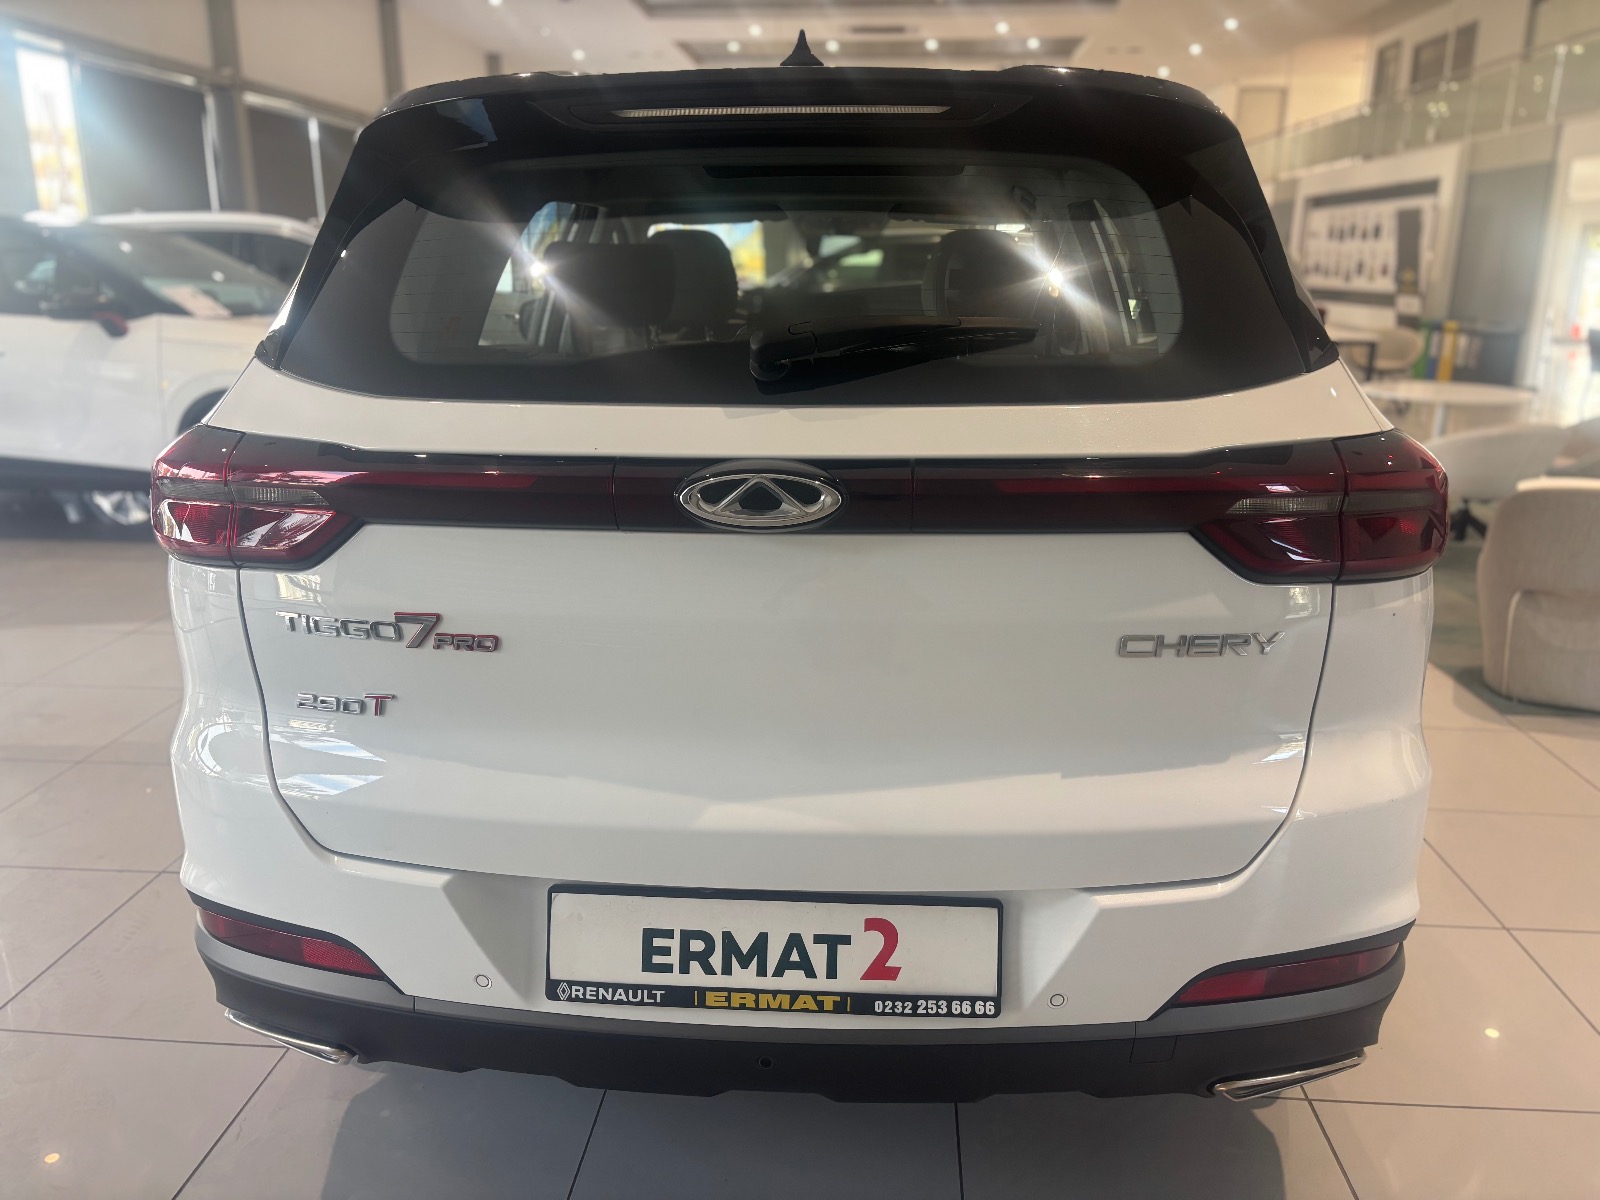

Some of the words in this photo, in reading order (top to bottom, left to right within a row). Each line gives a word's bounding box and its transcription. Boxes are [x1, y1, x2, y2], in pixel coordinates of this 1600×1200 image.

[1118, 631, 1286, 658] CHERY
[296, 693, 396, 716] 290T
[641, 927, 852, 980] ERMAT
[859, 917, 902, 981] 2
[571, 985, 666, 1003] RENAULT
[705, 990, 841, 1011] ERMAT
[874, 1000, 913, 1014] 0232
[916, 999, 948, 1014] 253
[951, 1000, 972, 1015] 66
[974, 1000, 995, 1015] 66
